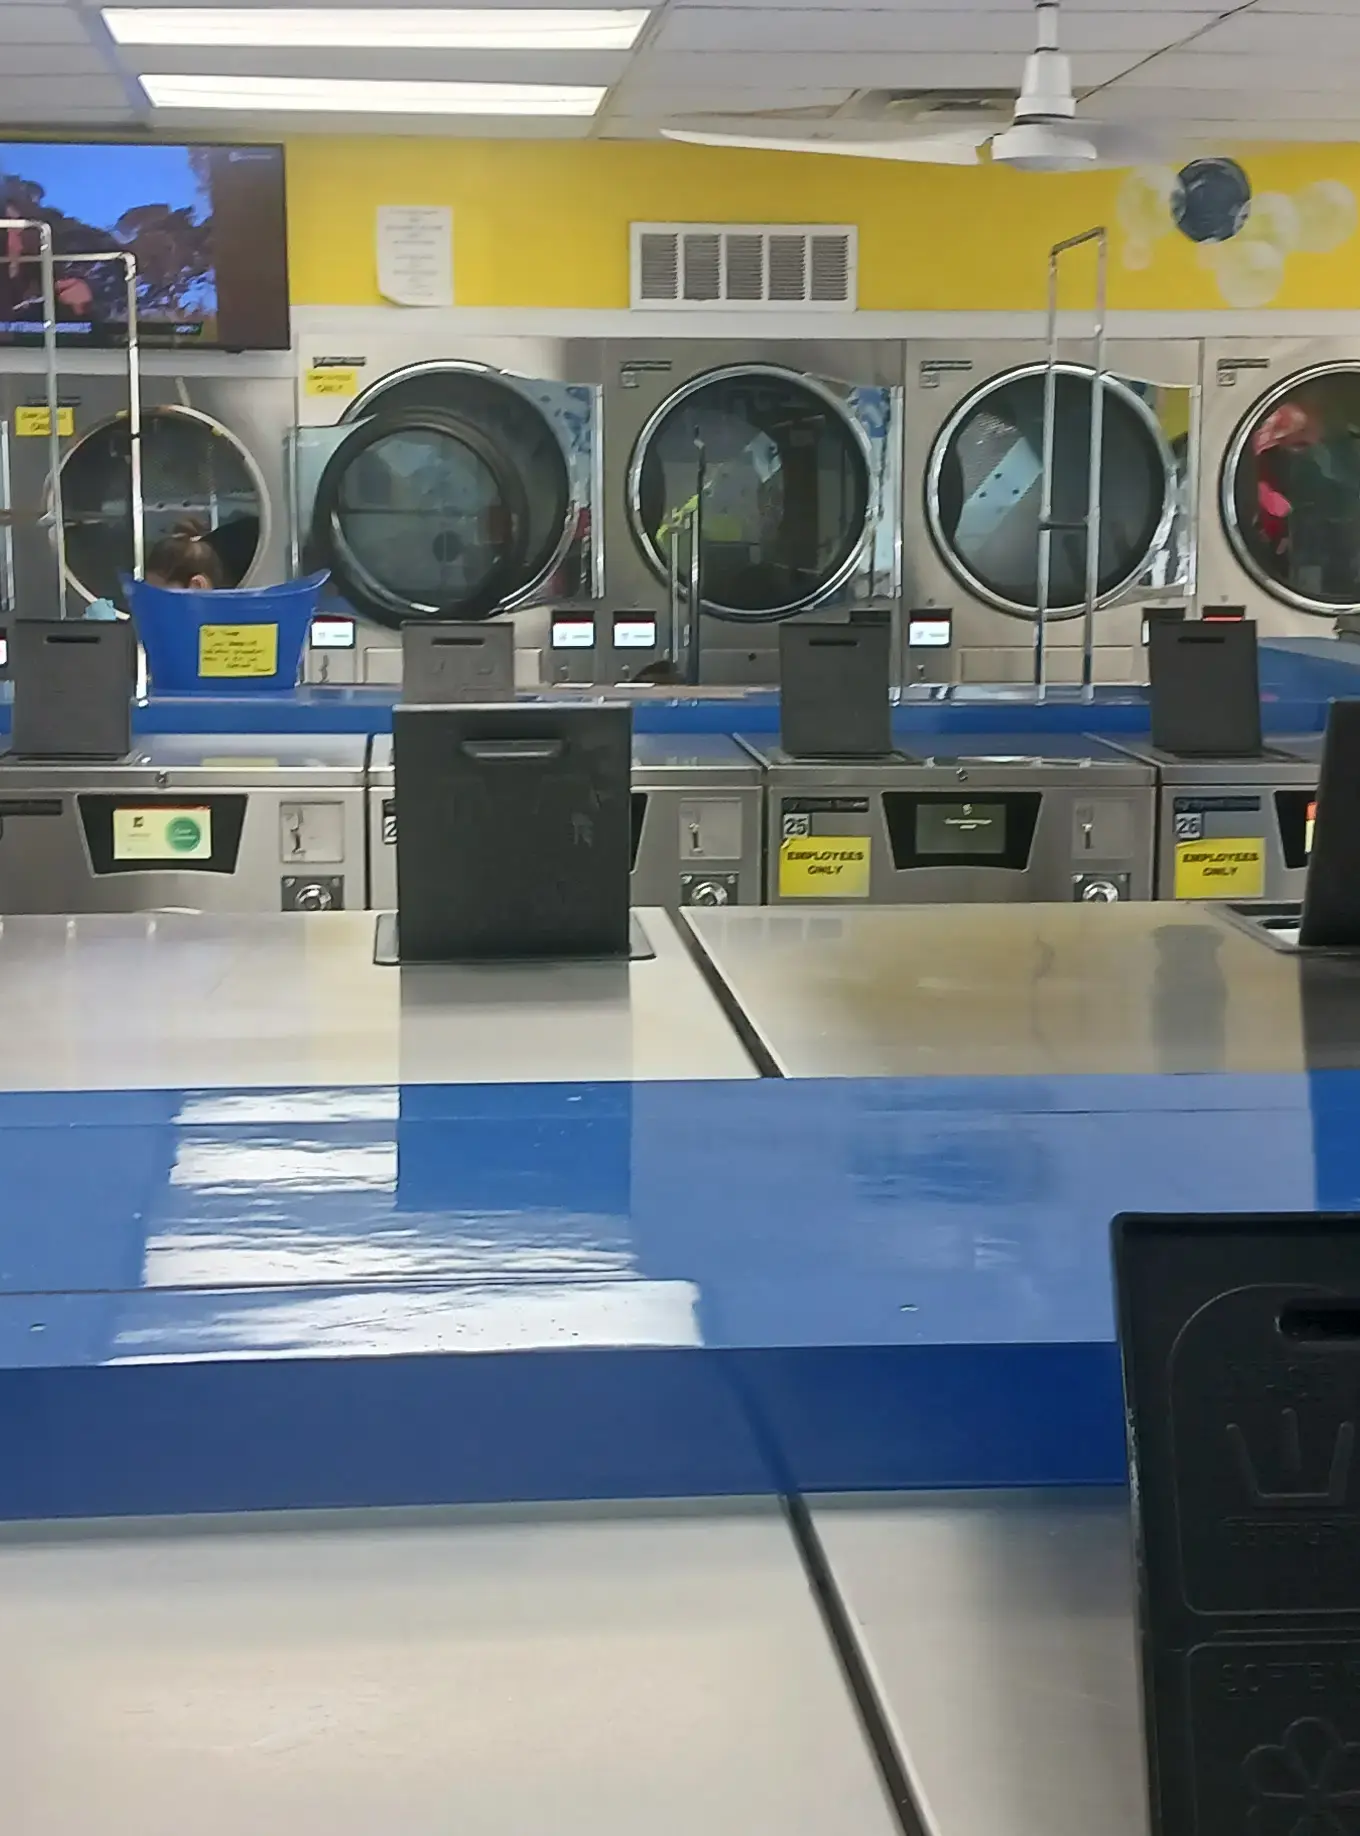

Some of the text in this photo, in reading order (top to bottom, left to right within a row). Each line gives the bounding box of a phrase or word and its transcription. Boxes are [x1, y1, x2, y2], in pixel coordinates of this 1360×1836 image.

[785, 818, 808, 836] 25
[786, 851, 864, 861] EMPLOYEES
[807, 864, 843, 875] ONLY
